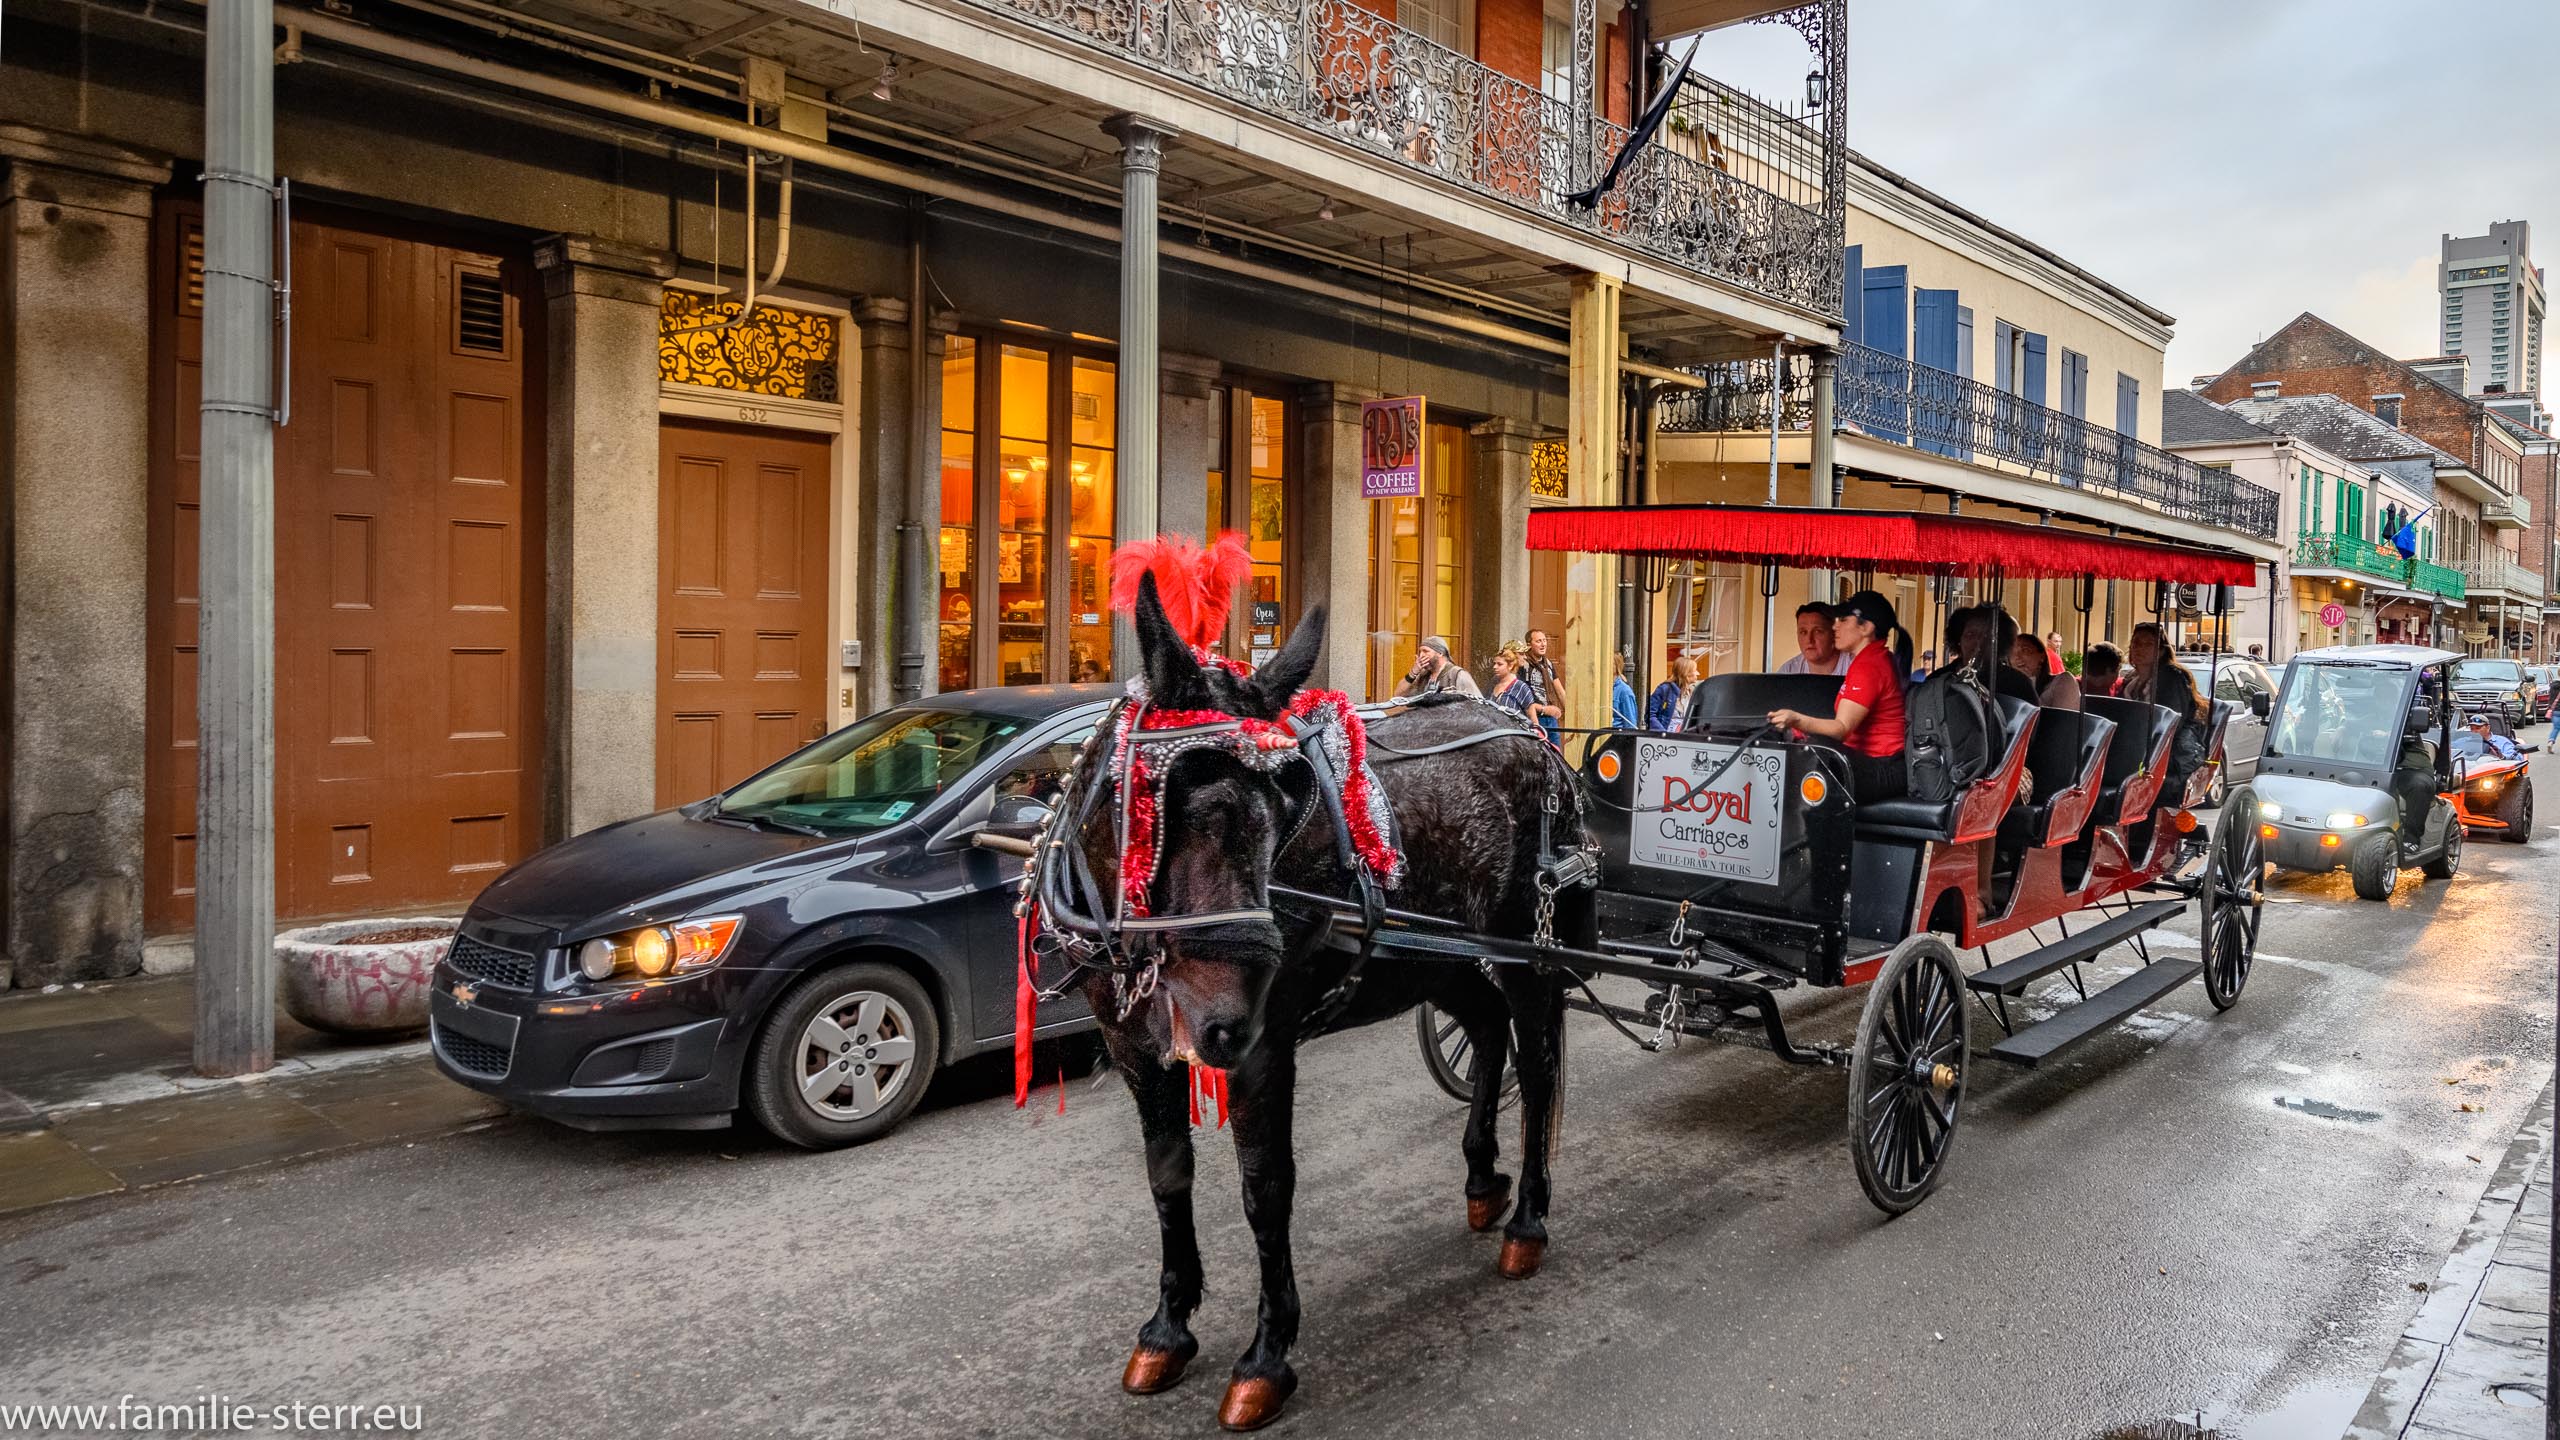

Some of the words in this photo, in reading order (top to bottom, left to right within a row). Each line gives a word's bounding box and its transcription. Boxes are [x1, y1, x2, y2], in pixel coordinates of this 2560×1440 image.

[738, 407, 767, 422] 632
[1366, 472, 1416, 489] COFFEE
[1390, 486, 1416, 494] ORLEANS
[1255, 606, 1275, 621] Open
[2323, 607, 2343, 624] STP
[1661, 776, 1752, 825] Royal
[1660, 817, 1749, 854] Carriages
[1656, 852, 1716, 870] MULE-DRAWN
[1719, 861, 1751, 875] TOURS
